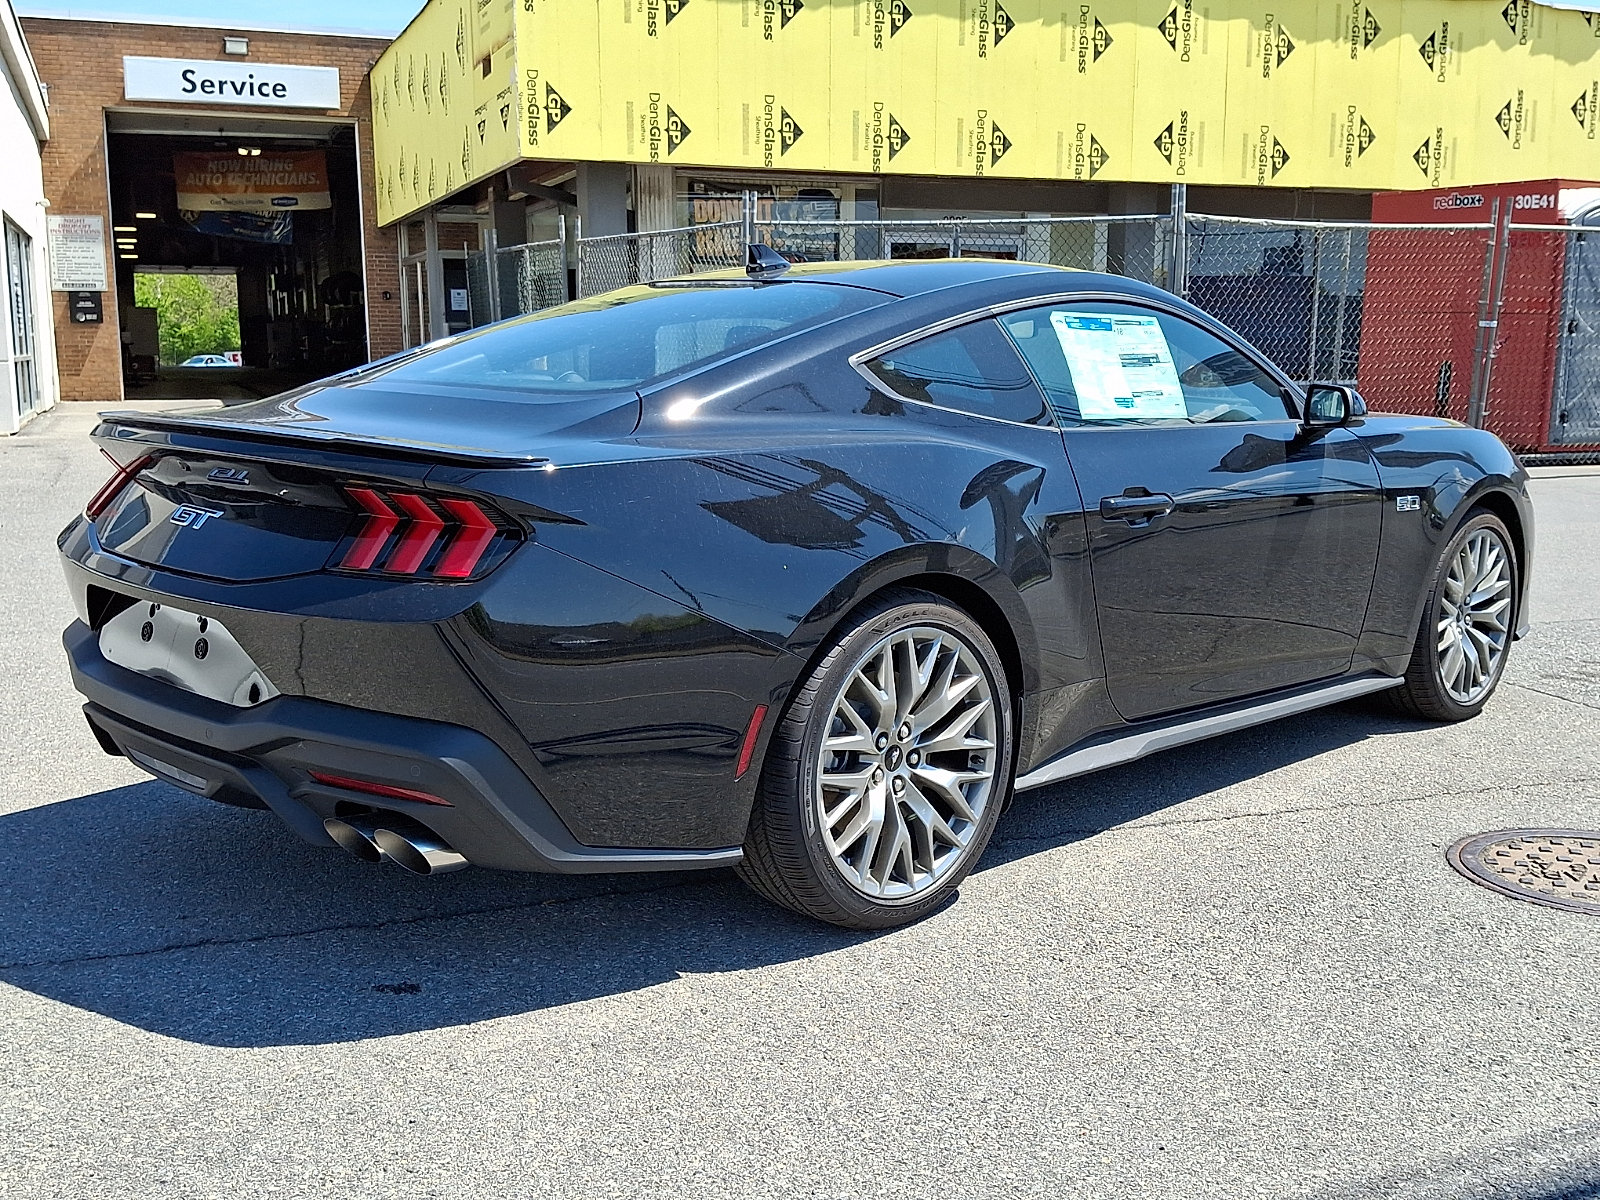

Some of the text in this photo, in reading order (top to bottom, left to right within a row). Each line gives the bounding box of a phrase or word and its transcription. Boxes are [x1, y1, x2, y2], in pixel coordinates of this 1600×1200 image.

[762, 0, 776, 40] Glass
[872, 0, 886, 49] sGlass
[891, 0, 904, 27] GP
[995, 10, 1007, 37] GP
[1507, 3, 1517, 27] GP
[979, 0, 990, 58] ensGlass
[1078, 3, 1091, 73] DensGlass
[1095, 26, 1106, 52] GP
[1165, 16, 1176, 42] GP
[1366, 16, 1375, 40] GP
[1263, 14, 1275, 78] DensGlass
[1278, 34, 1288, 58] GP
[1424, 40, 1434, 64] GP
[181, 69, 287, 98] Service
[527, 69, 540, 145] DensGlass
[547, 93, 562, 122] GP
[1500, 107, 1510, 131] GP
[1576, 98, 1585, 122] GP
[668, 116, 681, 144] GP
[764, 95, 775, 167] DensGlass
[782, 117, 794, 145] GP
[873, 102, 883, 172] DensGlass
[890, 124, 902, 151] GP
[1161, 131, 1172, 156] GP
[1174, 111, 1188, 175] DensGlass
[1343, 105, 1358, 167] DensGlass
[1360, 124, 1370, 148] GP
[993, 131, 1004, 157] GP
[1075, 123, 1086, 179] DensGlas
[1091, 143, 1102, 169] GP
[1273, 144, 1284, 169] GP
[1418, 145, 1428, 169] GP
[185, 173, 223, 185] AUTO
[209, 160, 294, 172] NOW HIRING
[1433, 194, 1484, 210] redbox+
[1515, 194, 1556, 209] 30E41
[169, 503, 225, 530] GT
